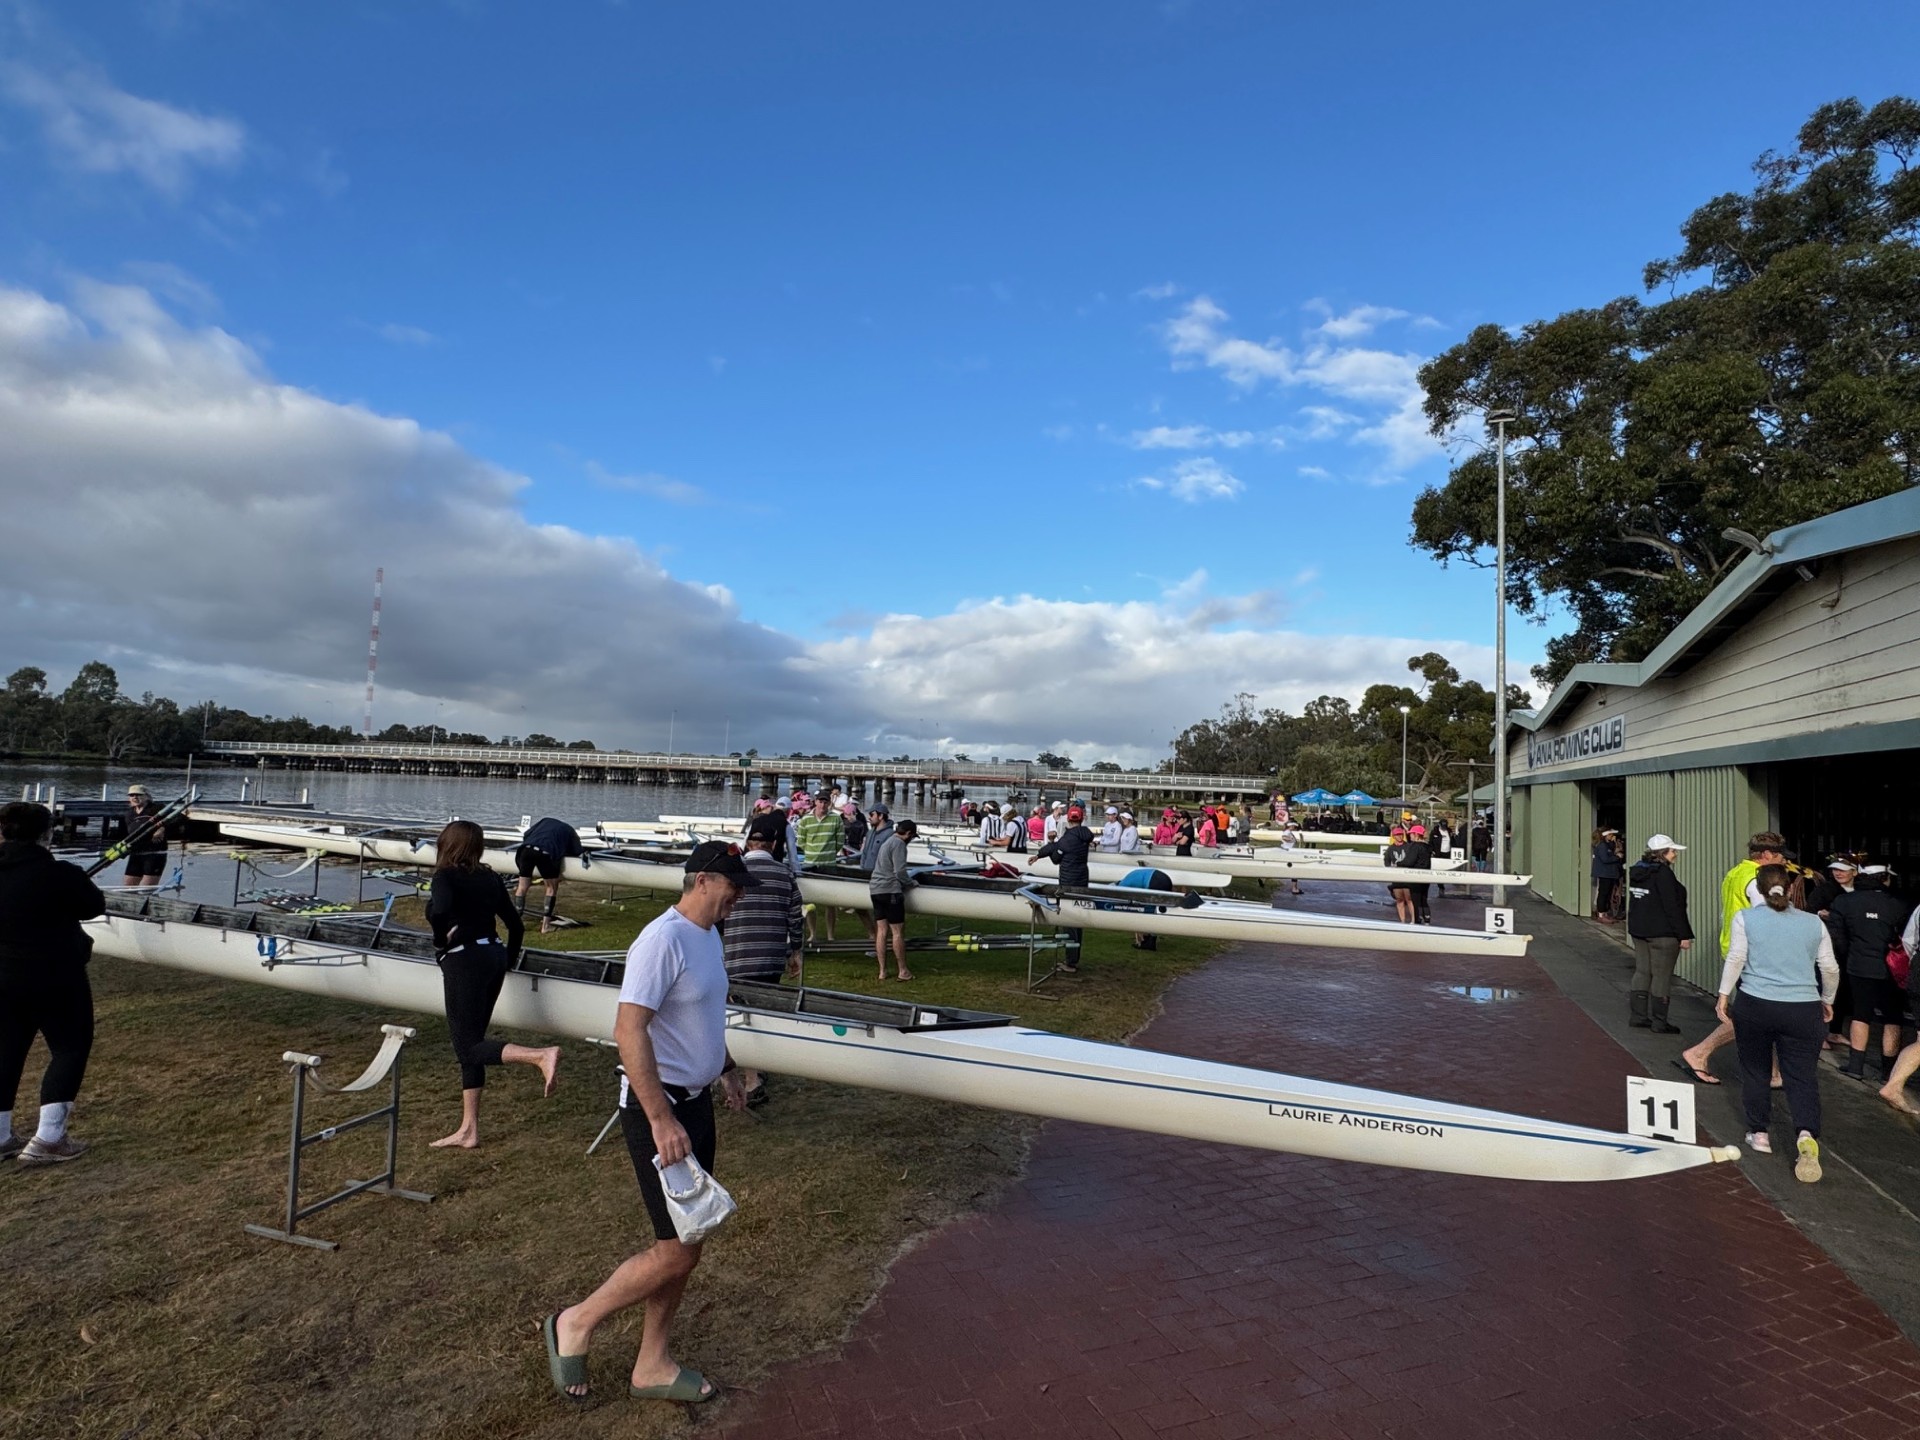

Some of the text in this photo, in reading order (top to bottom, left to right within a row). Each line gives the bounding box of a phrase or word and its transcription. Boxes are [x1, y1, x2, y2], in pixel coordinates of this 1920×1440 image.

[1536, 719, 1622, 765] ANA ROWING CLUB
[1453, 851, 1462, 859] 16
[1494, 913, 1505, 927] 5
[1268, 1104, 1444, 1138] LAURIE ANDERSON
[1639, 1096, 1679, 1130] 11
